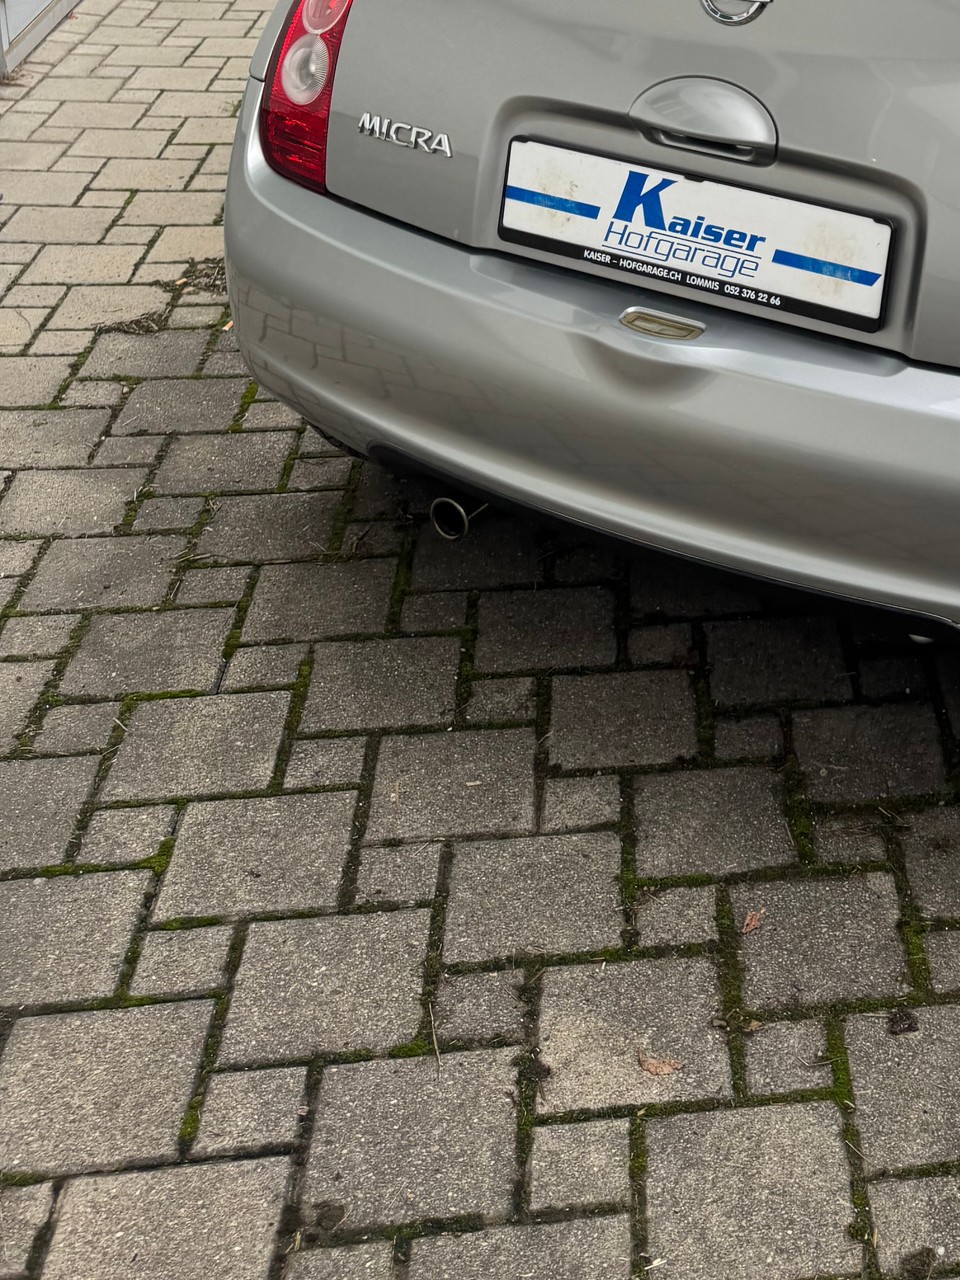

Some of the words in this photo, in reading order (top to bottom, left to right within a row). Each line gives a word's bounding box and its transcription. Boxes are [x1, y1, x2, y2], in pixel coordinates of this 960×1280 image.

[358, 112, 453, 158] MICRA
[612, 170, 766, 252] Kaiser
[583, 249, 612, 264] KAISER
[619, 258, 682, 281] HOFGARAGE.CH
[686, 274, 720, 291] LOMMIS
[724, 284, 740, 296] 052
[741, 288, 756, 300] 376
[757, 293, 768, 302] 22
[769, 296, 781, 306] 66
[602, 221, 762, 278] Hofgarage
